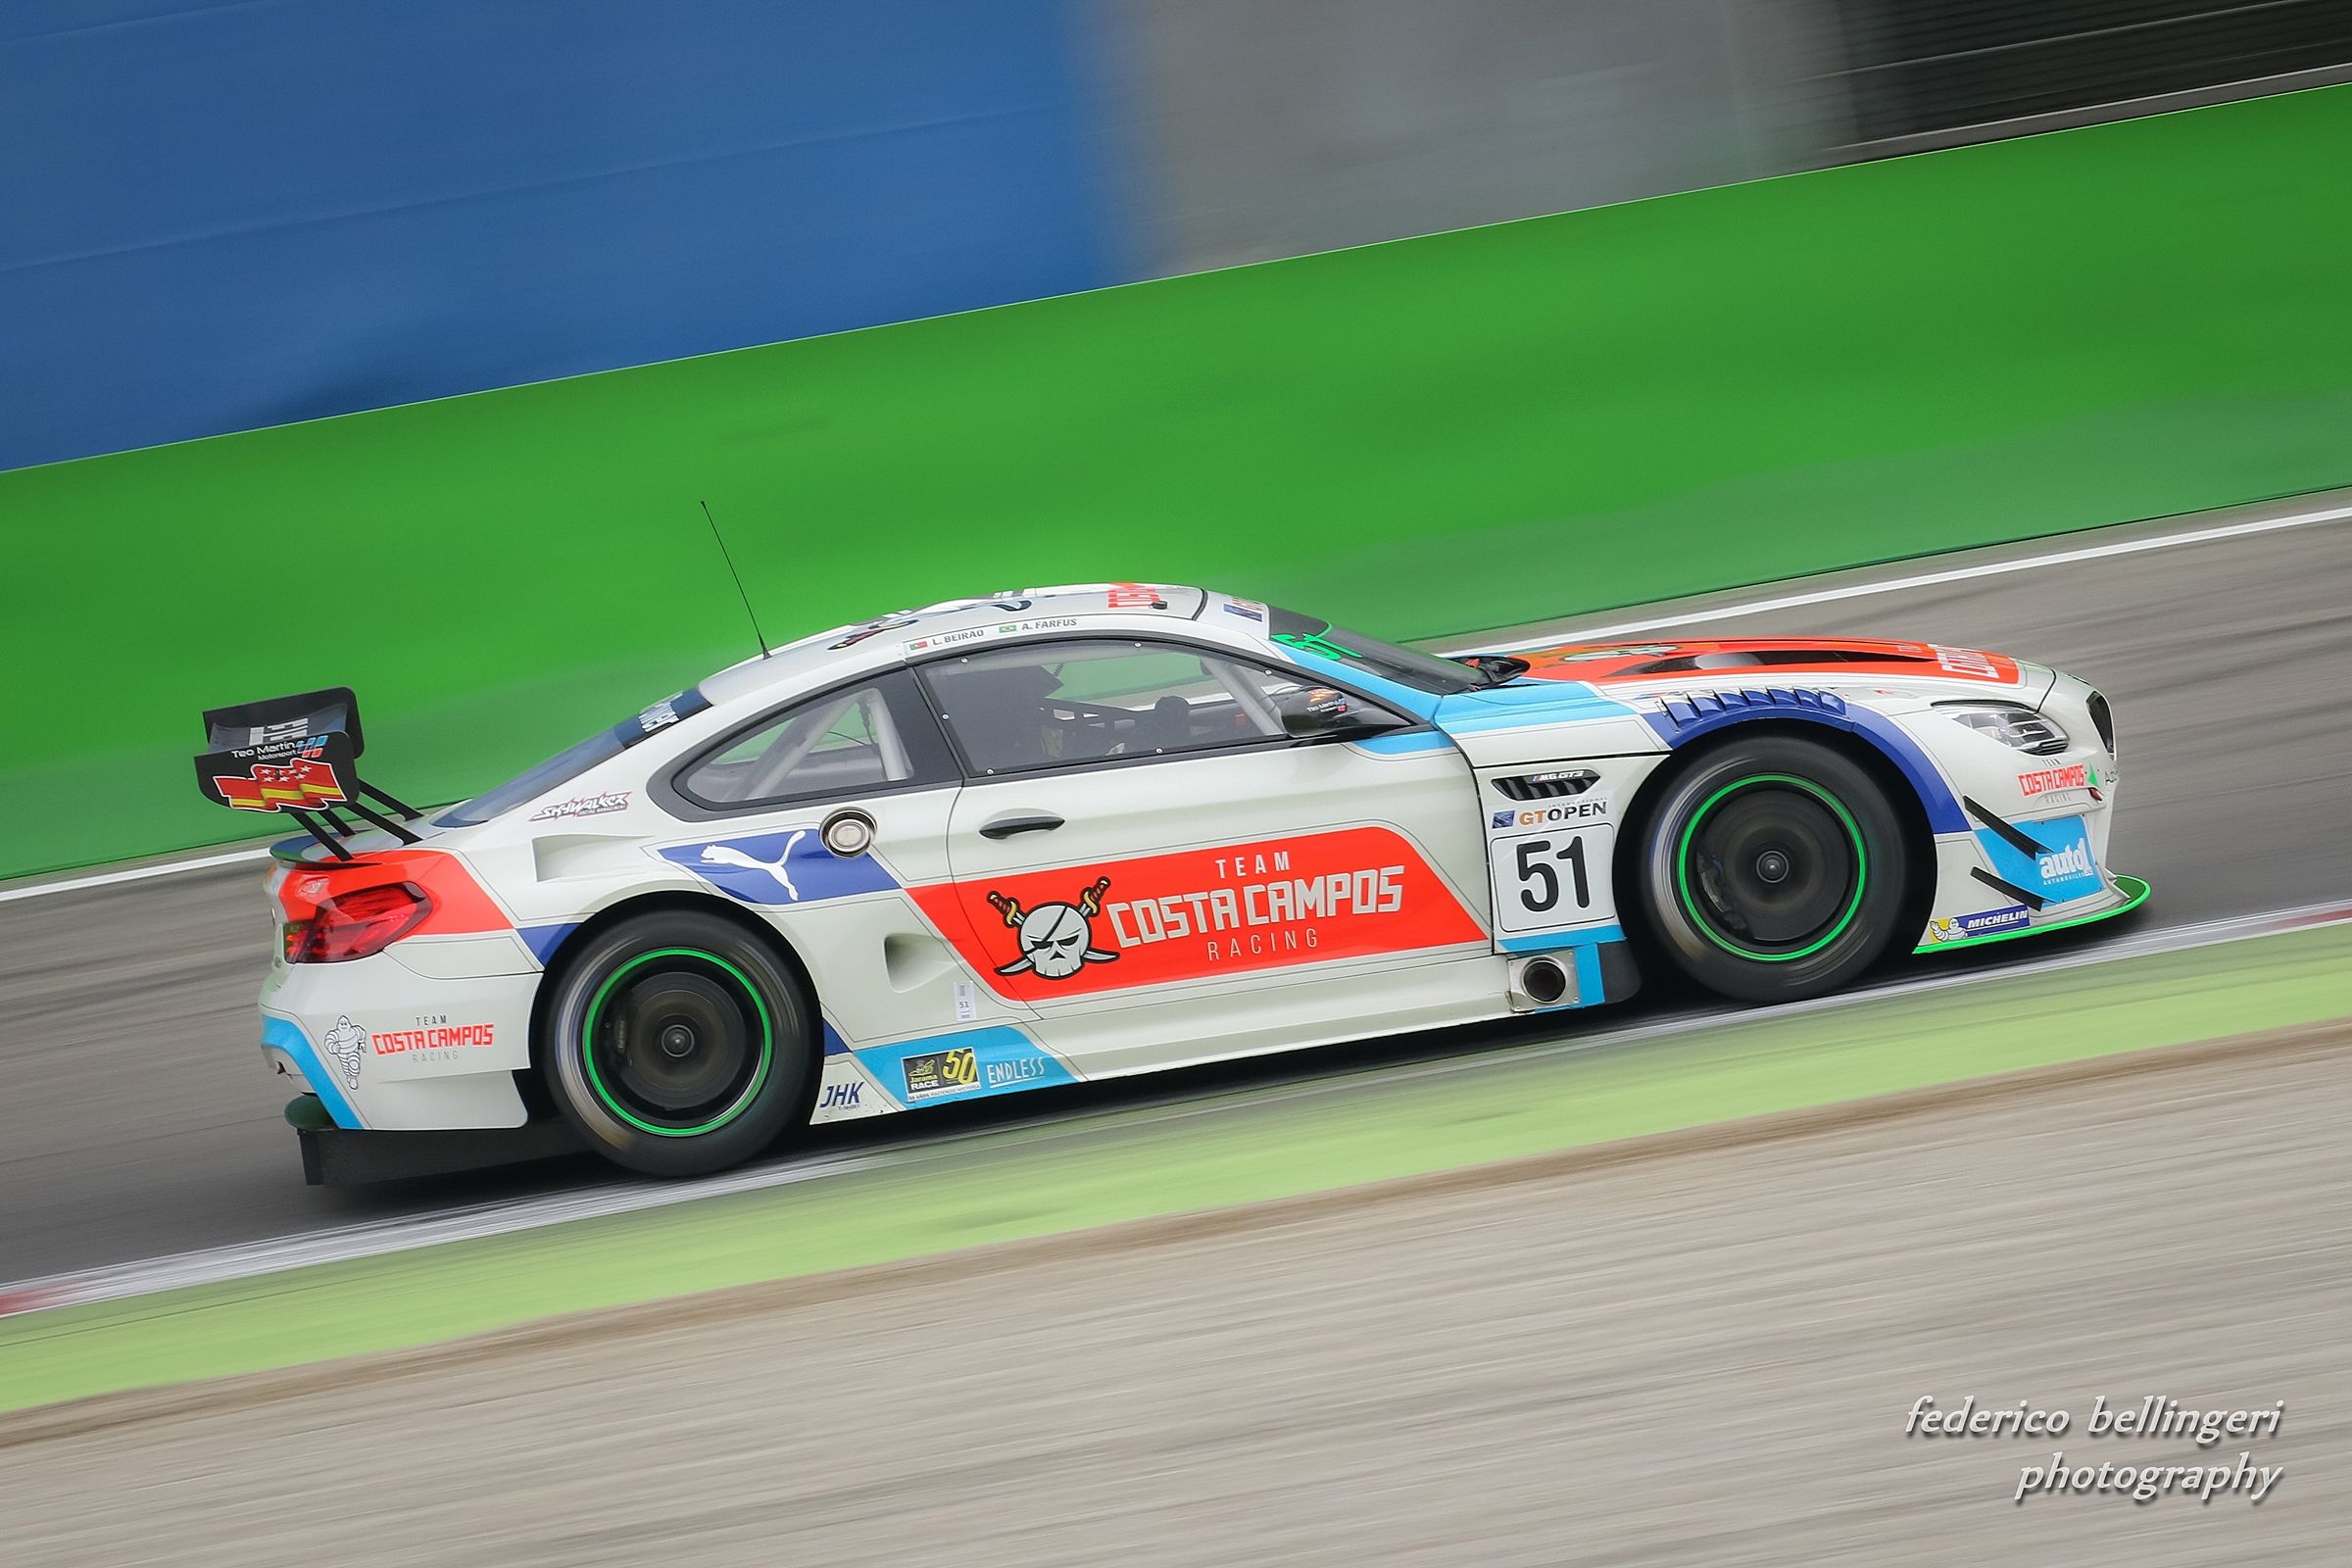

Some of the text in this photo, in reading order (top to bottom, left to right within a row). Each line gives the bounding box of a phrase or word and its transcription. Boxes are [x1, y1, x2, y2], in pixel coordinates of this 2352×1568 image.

[1036, 618, 1078, 629] FARFUS
[230, 742, 296, 759] Teo Martin
[1215, 851, 1291, 879] TEAM
[1516, 836, 1590, 912] 51
[1105, 865, 1405, 949] COSTA CAMPOS
[1967, 909, 2029, 929] MICHELIN
[1207, 927, 1318, 961] RACING
[416, 1014, 447, 1026] TEAM
[371, 1023, 495, 1055] COSTA CAMPOS
[412, 1051, 459, 1063] RACING
[943, 1050, 976, 1085] 50
[987, 1057, 1046, 1084] ENDLESS
[819, 1081, 864, 1108] JHK
[909, 1080, 940, 1091] RACE
